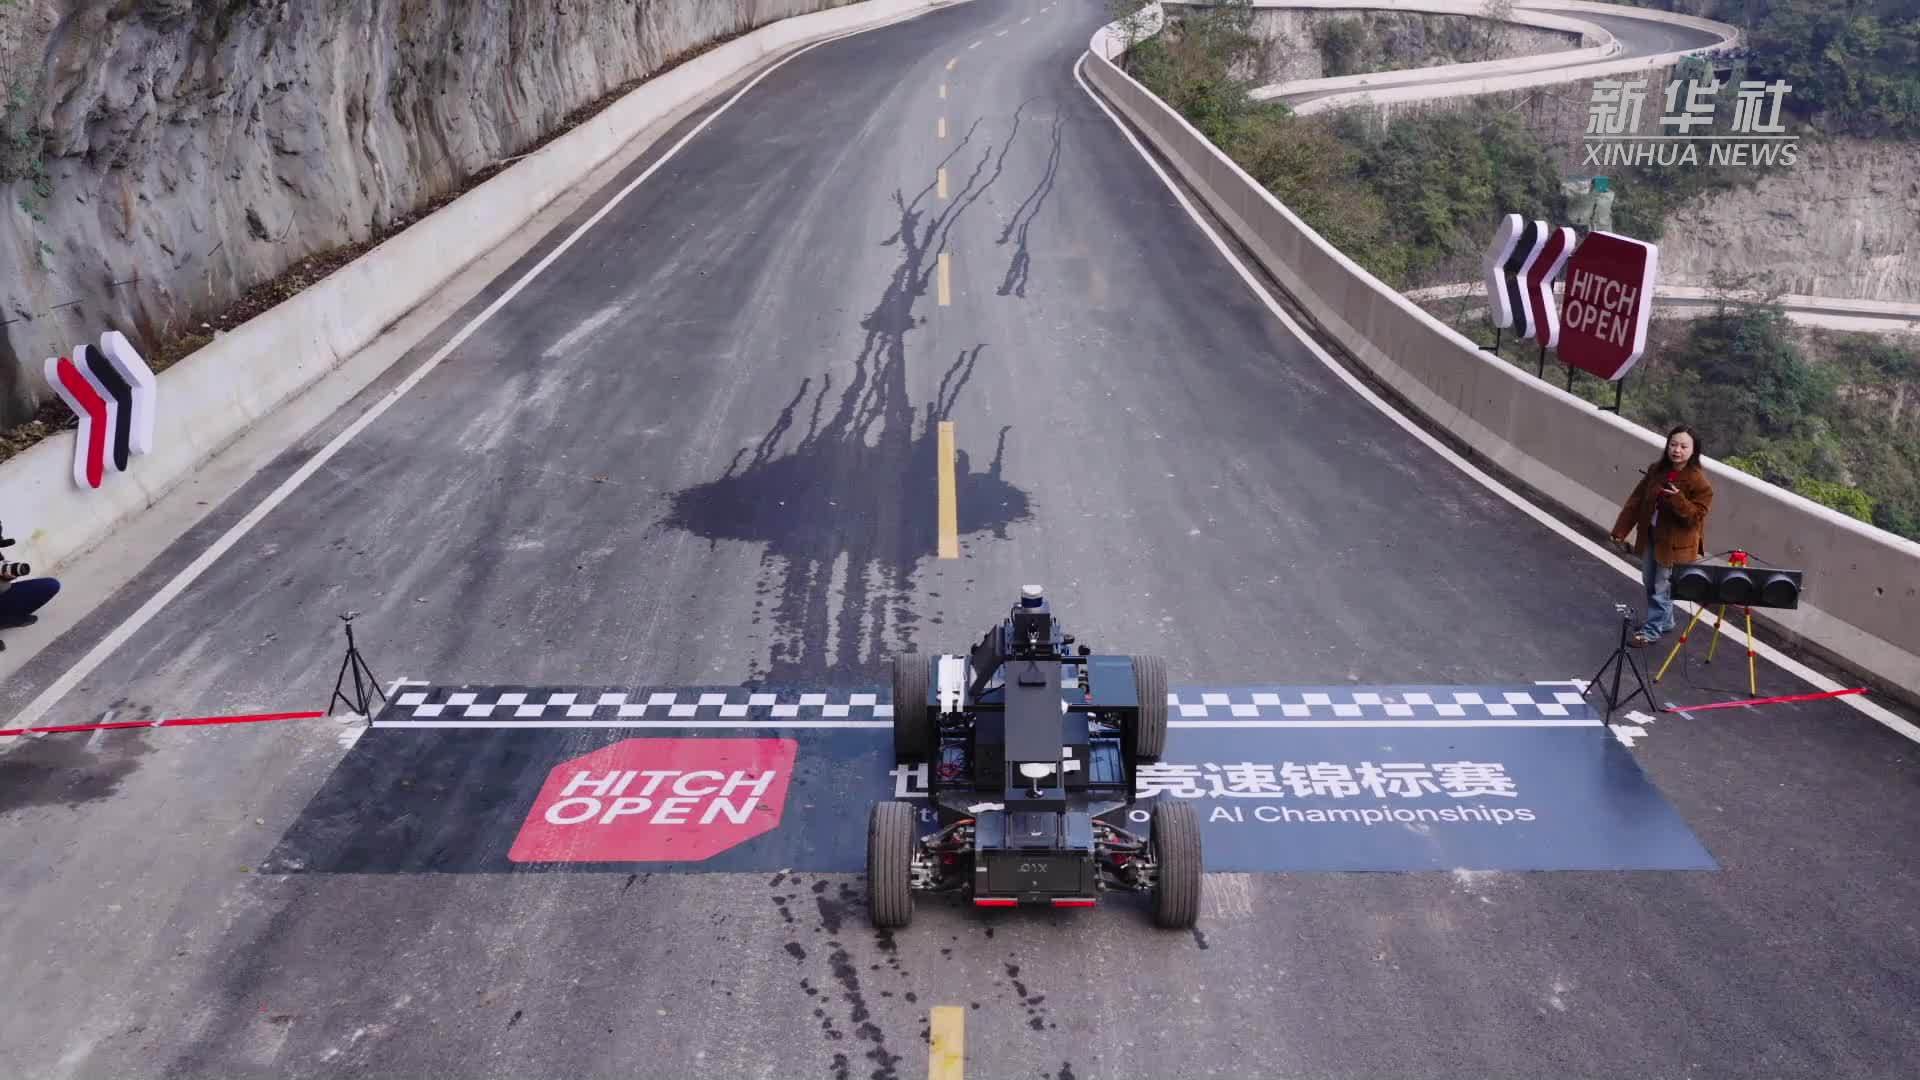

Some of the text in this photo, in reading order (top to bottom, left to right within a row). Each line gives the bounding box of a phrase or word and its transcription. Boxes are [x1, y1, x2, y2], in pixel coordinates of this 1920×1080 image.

[1570, 268, 1637, 316] HITCH
[1566, 300, 1630, 347] OPEN
[560, 770, 776, 796] HITCH
[544, 797, 760, 825] OPEN
[1209, 805, 1536, 825] AI Championships
